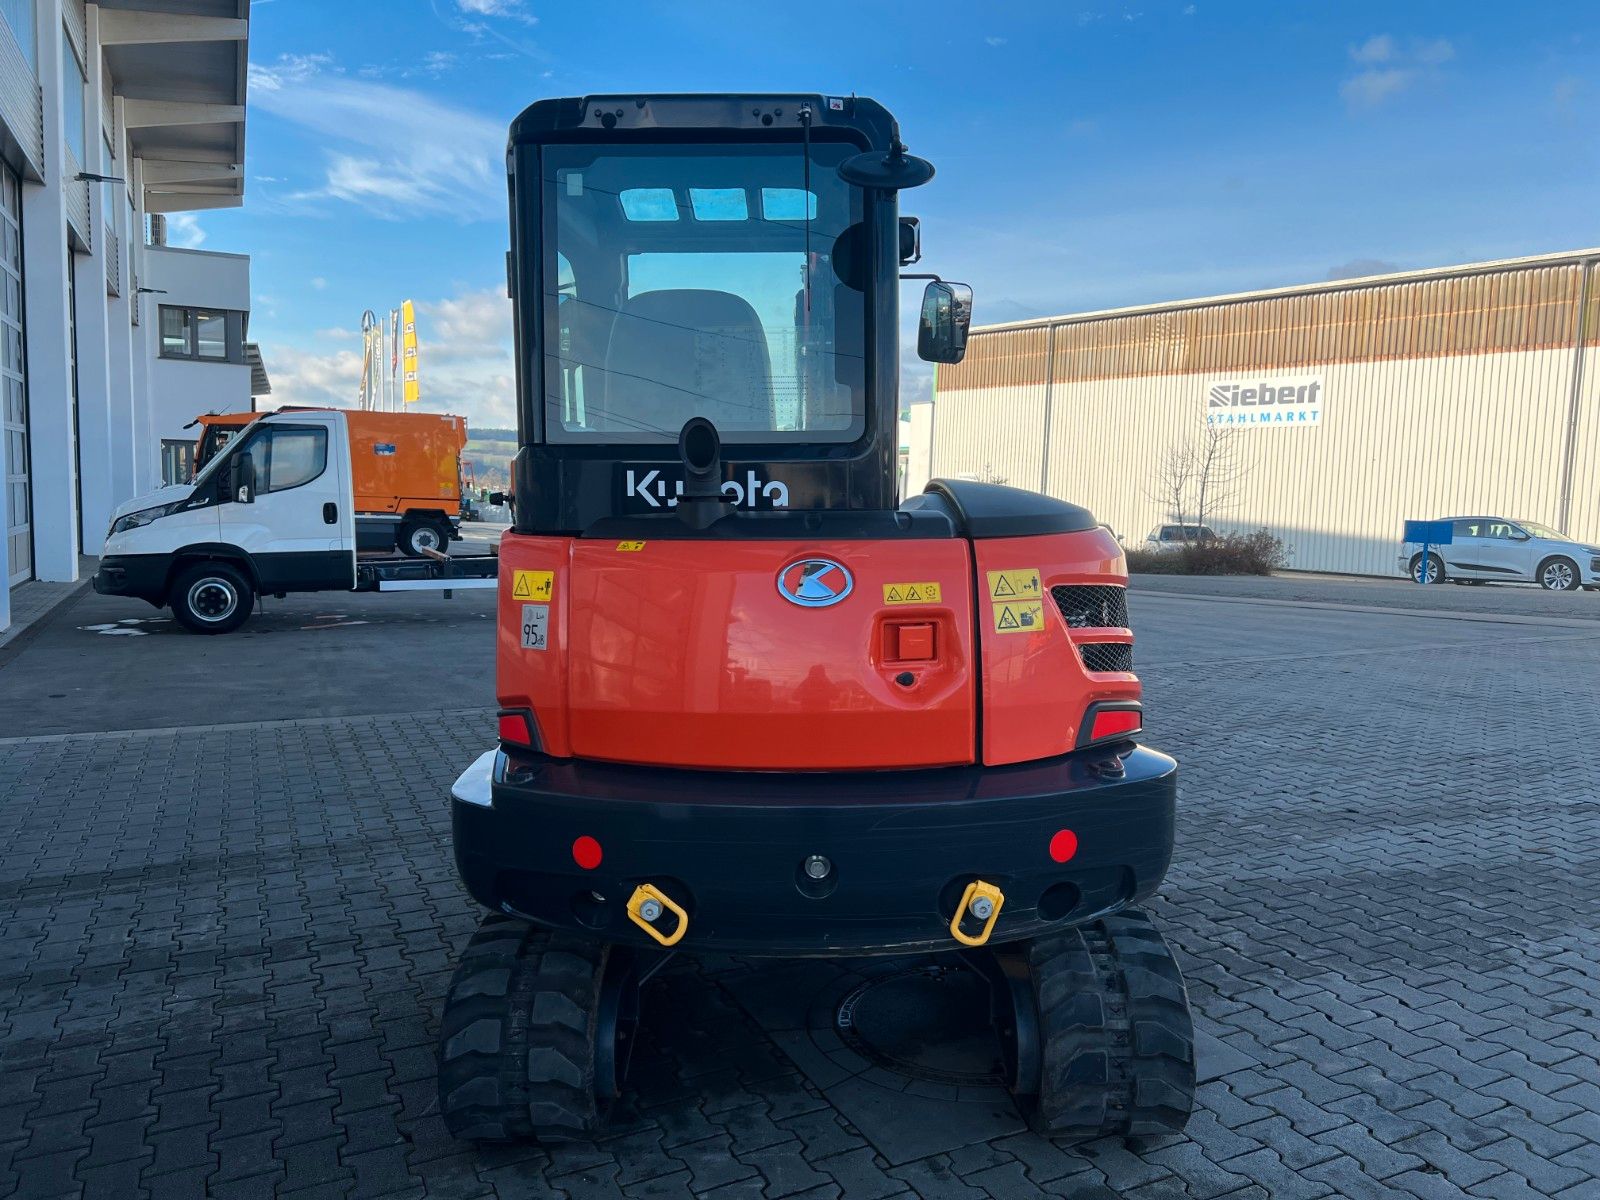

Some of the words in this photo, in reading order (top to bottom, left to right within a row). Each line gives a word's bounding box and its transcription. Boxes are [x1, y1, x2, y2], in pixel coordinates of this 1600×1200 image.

[1209, 380, 1321, 407] Siebert
[1207, 410, 1319, 425] STAHLMARKT
[626, 470, 789, 507] Kuota
